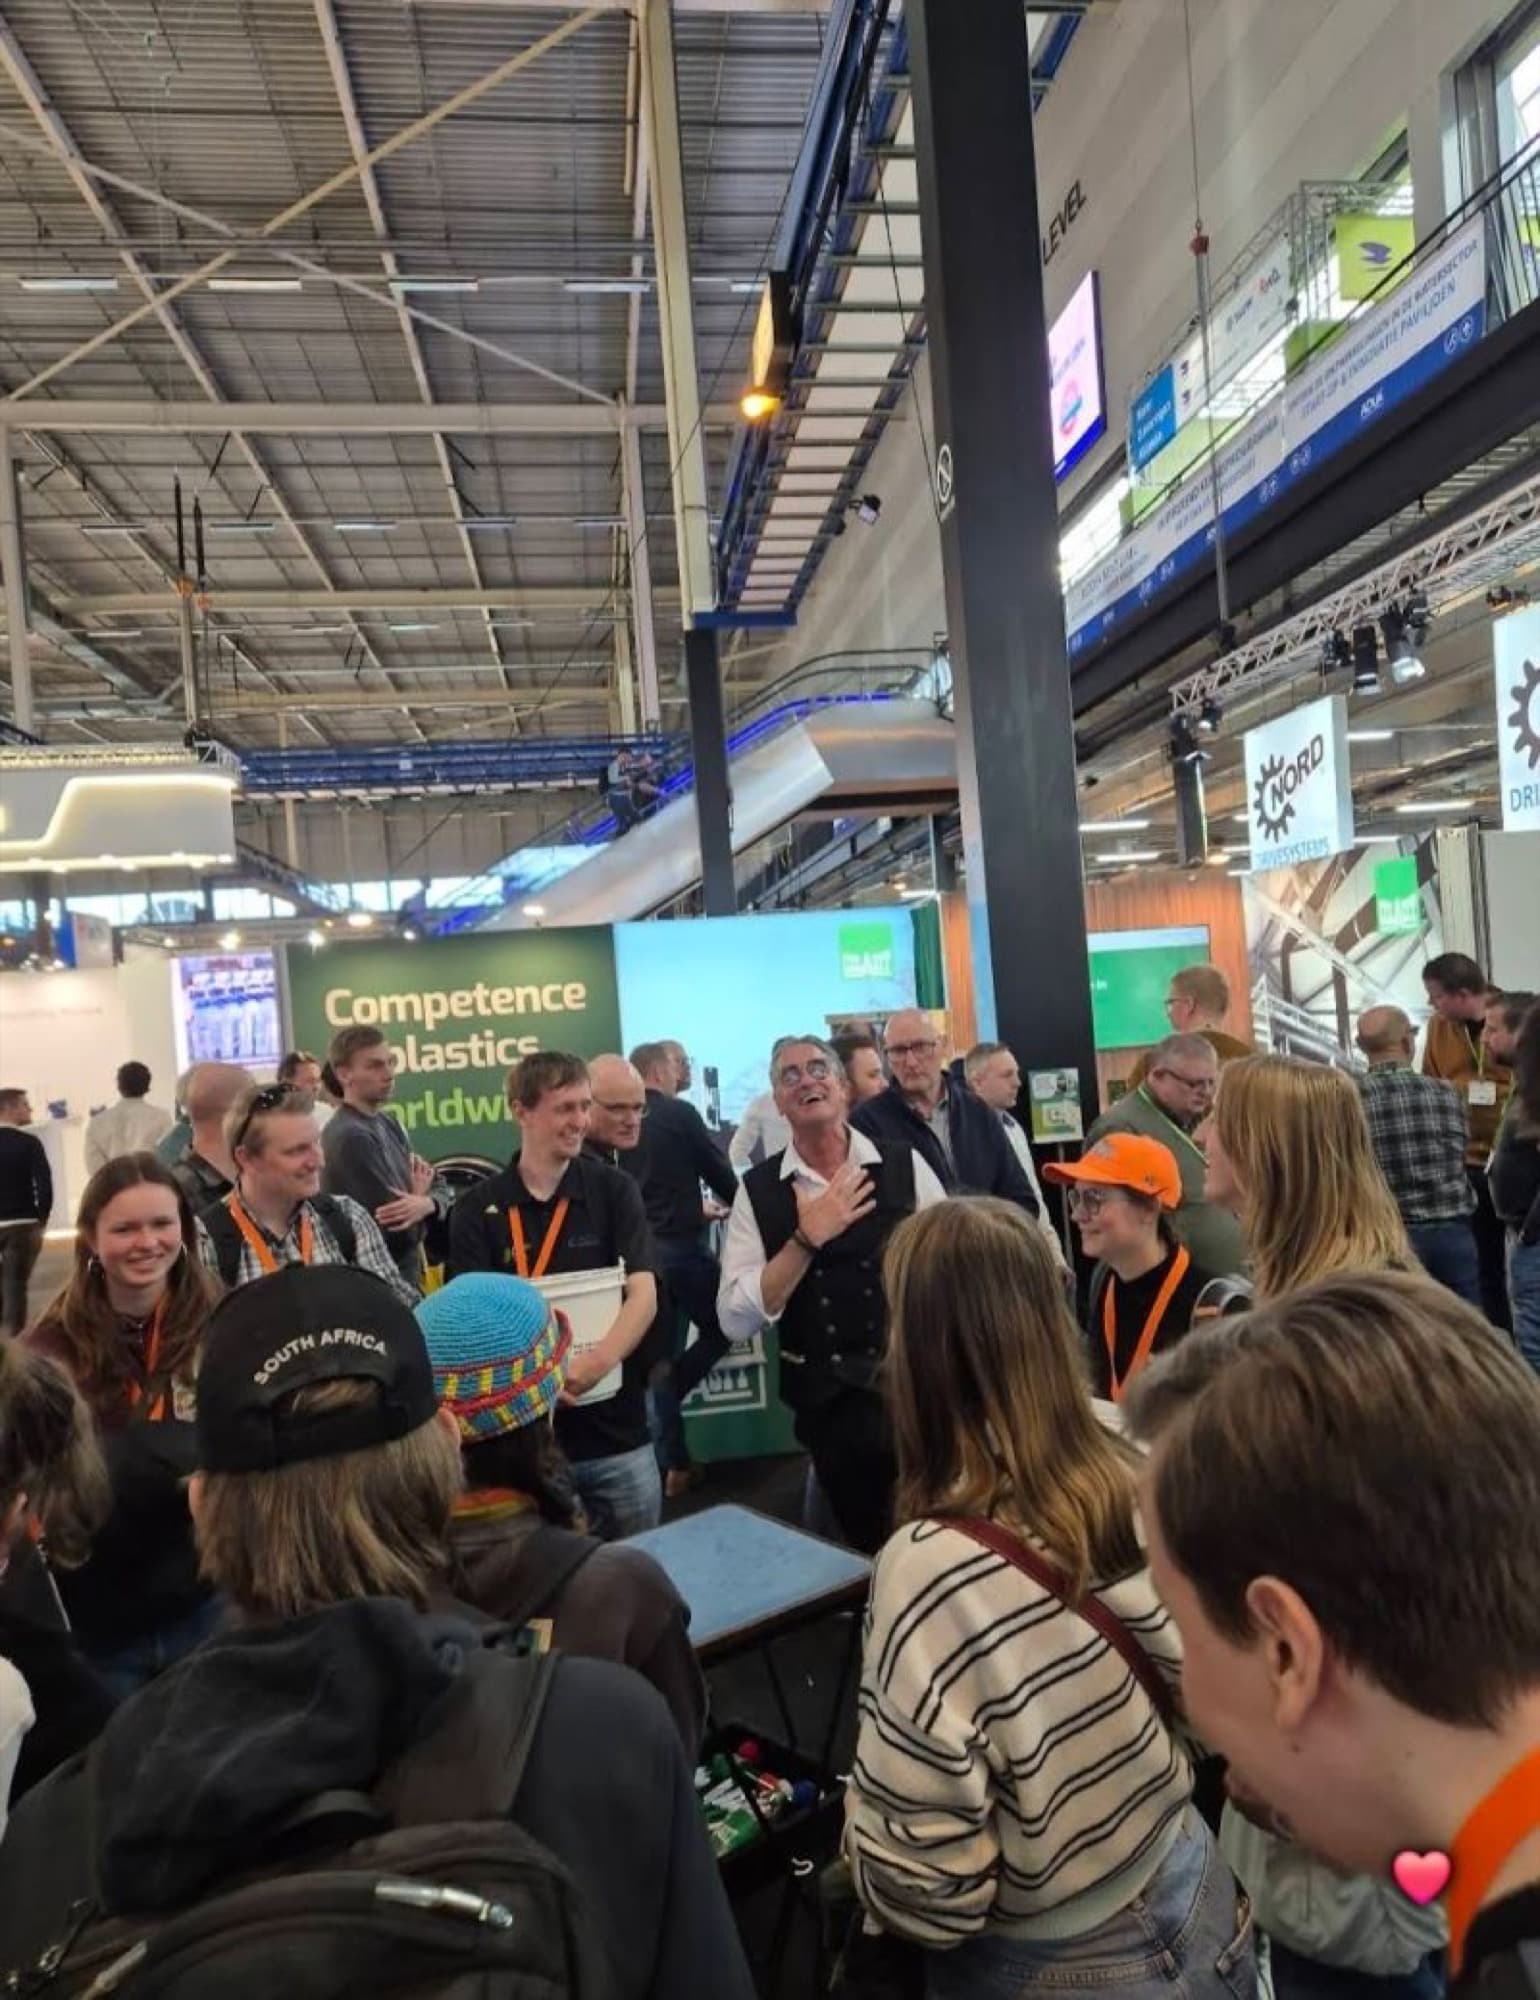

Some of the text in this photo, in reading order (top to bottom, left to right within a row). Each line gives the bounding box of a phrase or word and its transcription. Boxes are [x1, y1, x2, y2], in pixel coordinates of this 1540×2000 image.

[1042, 180, 1087, 267] LEVEL
[1414, 238, 1478, 302] WATERSECTOR
[1271, 733, 1324, 813] NORD
[325, 982, 586, 1030] Competence
[253, 1327, 388, 1385] SOUTH AFRICA
